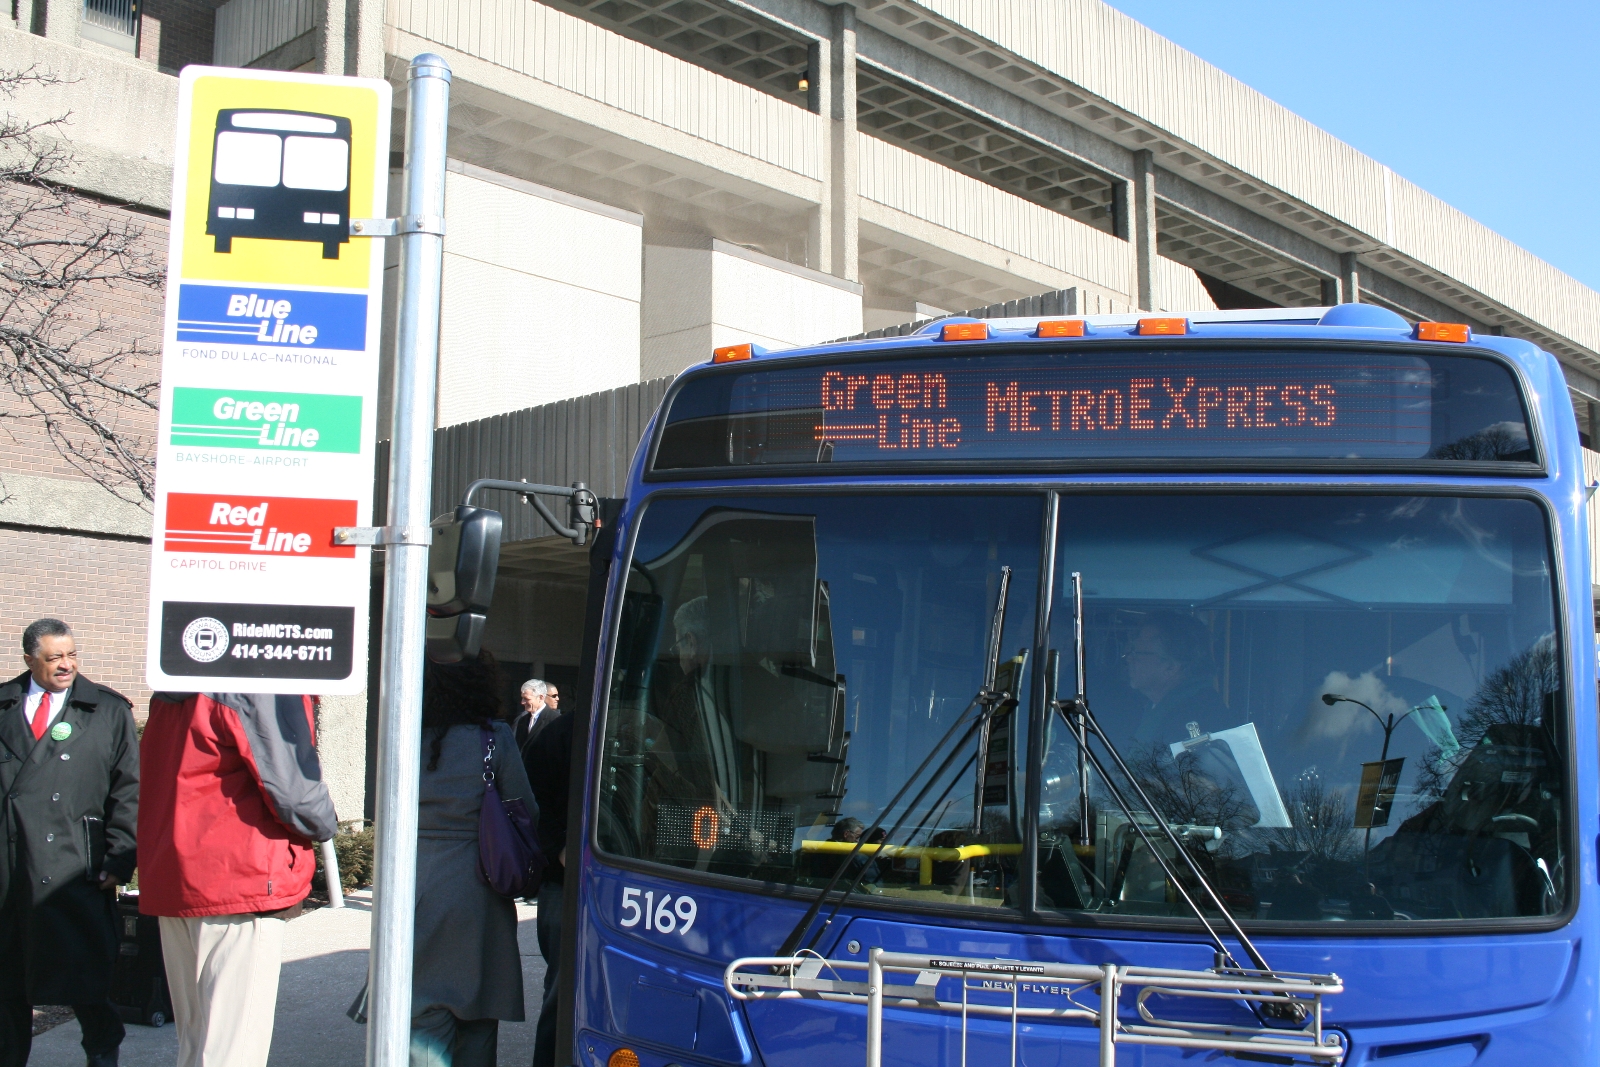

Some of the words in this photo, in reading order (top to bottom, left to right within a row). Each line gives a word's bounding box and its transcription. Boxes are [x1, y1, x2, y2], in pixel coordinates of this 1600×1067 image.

[226, 293, 292, 319] Blue
[257, 319, 318, 345] Line
[182, 348, 217, 360] FOND
[221, 350, 239, 361] DU
[821, 370, 947, 411] Green
[213, 396, 300, 423] Green
[258, 422, 320, 448] Line
[878, 412, 962, 449] Line
[209, 502, 269, 527] Red
[249, 527, 312, 553] Line
[170, 558, 225, 570] CAPITOL
[229, 560, 267, 572] DRIVE
[188, 621, 224, 641] MILWAUKEE
[232, 622, 333, 640] RideMCTS.com
[190, 645, 220, 658] COUNTY
[231, 643, 332, 661] 414-344-6711
[620, 886, 697, 935] 5169
[982, 980, 1015, 991] NEW
[1022, 984, 1070, 995] FLYER
